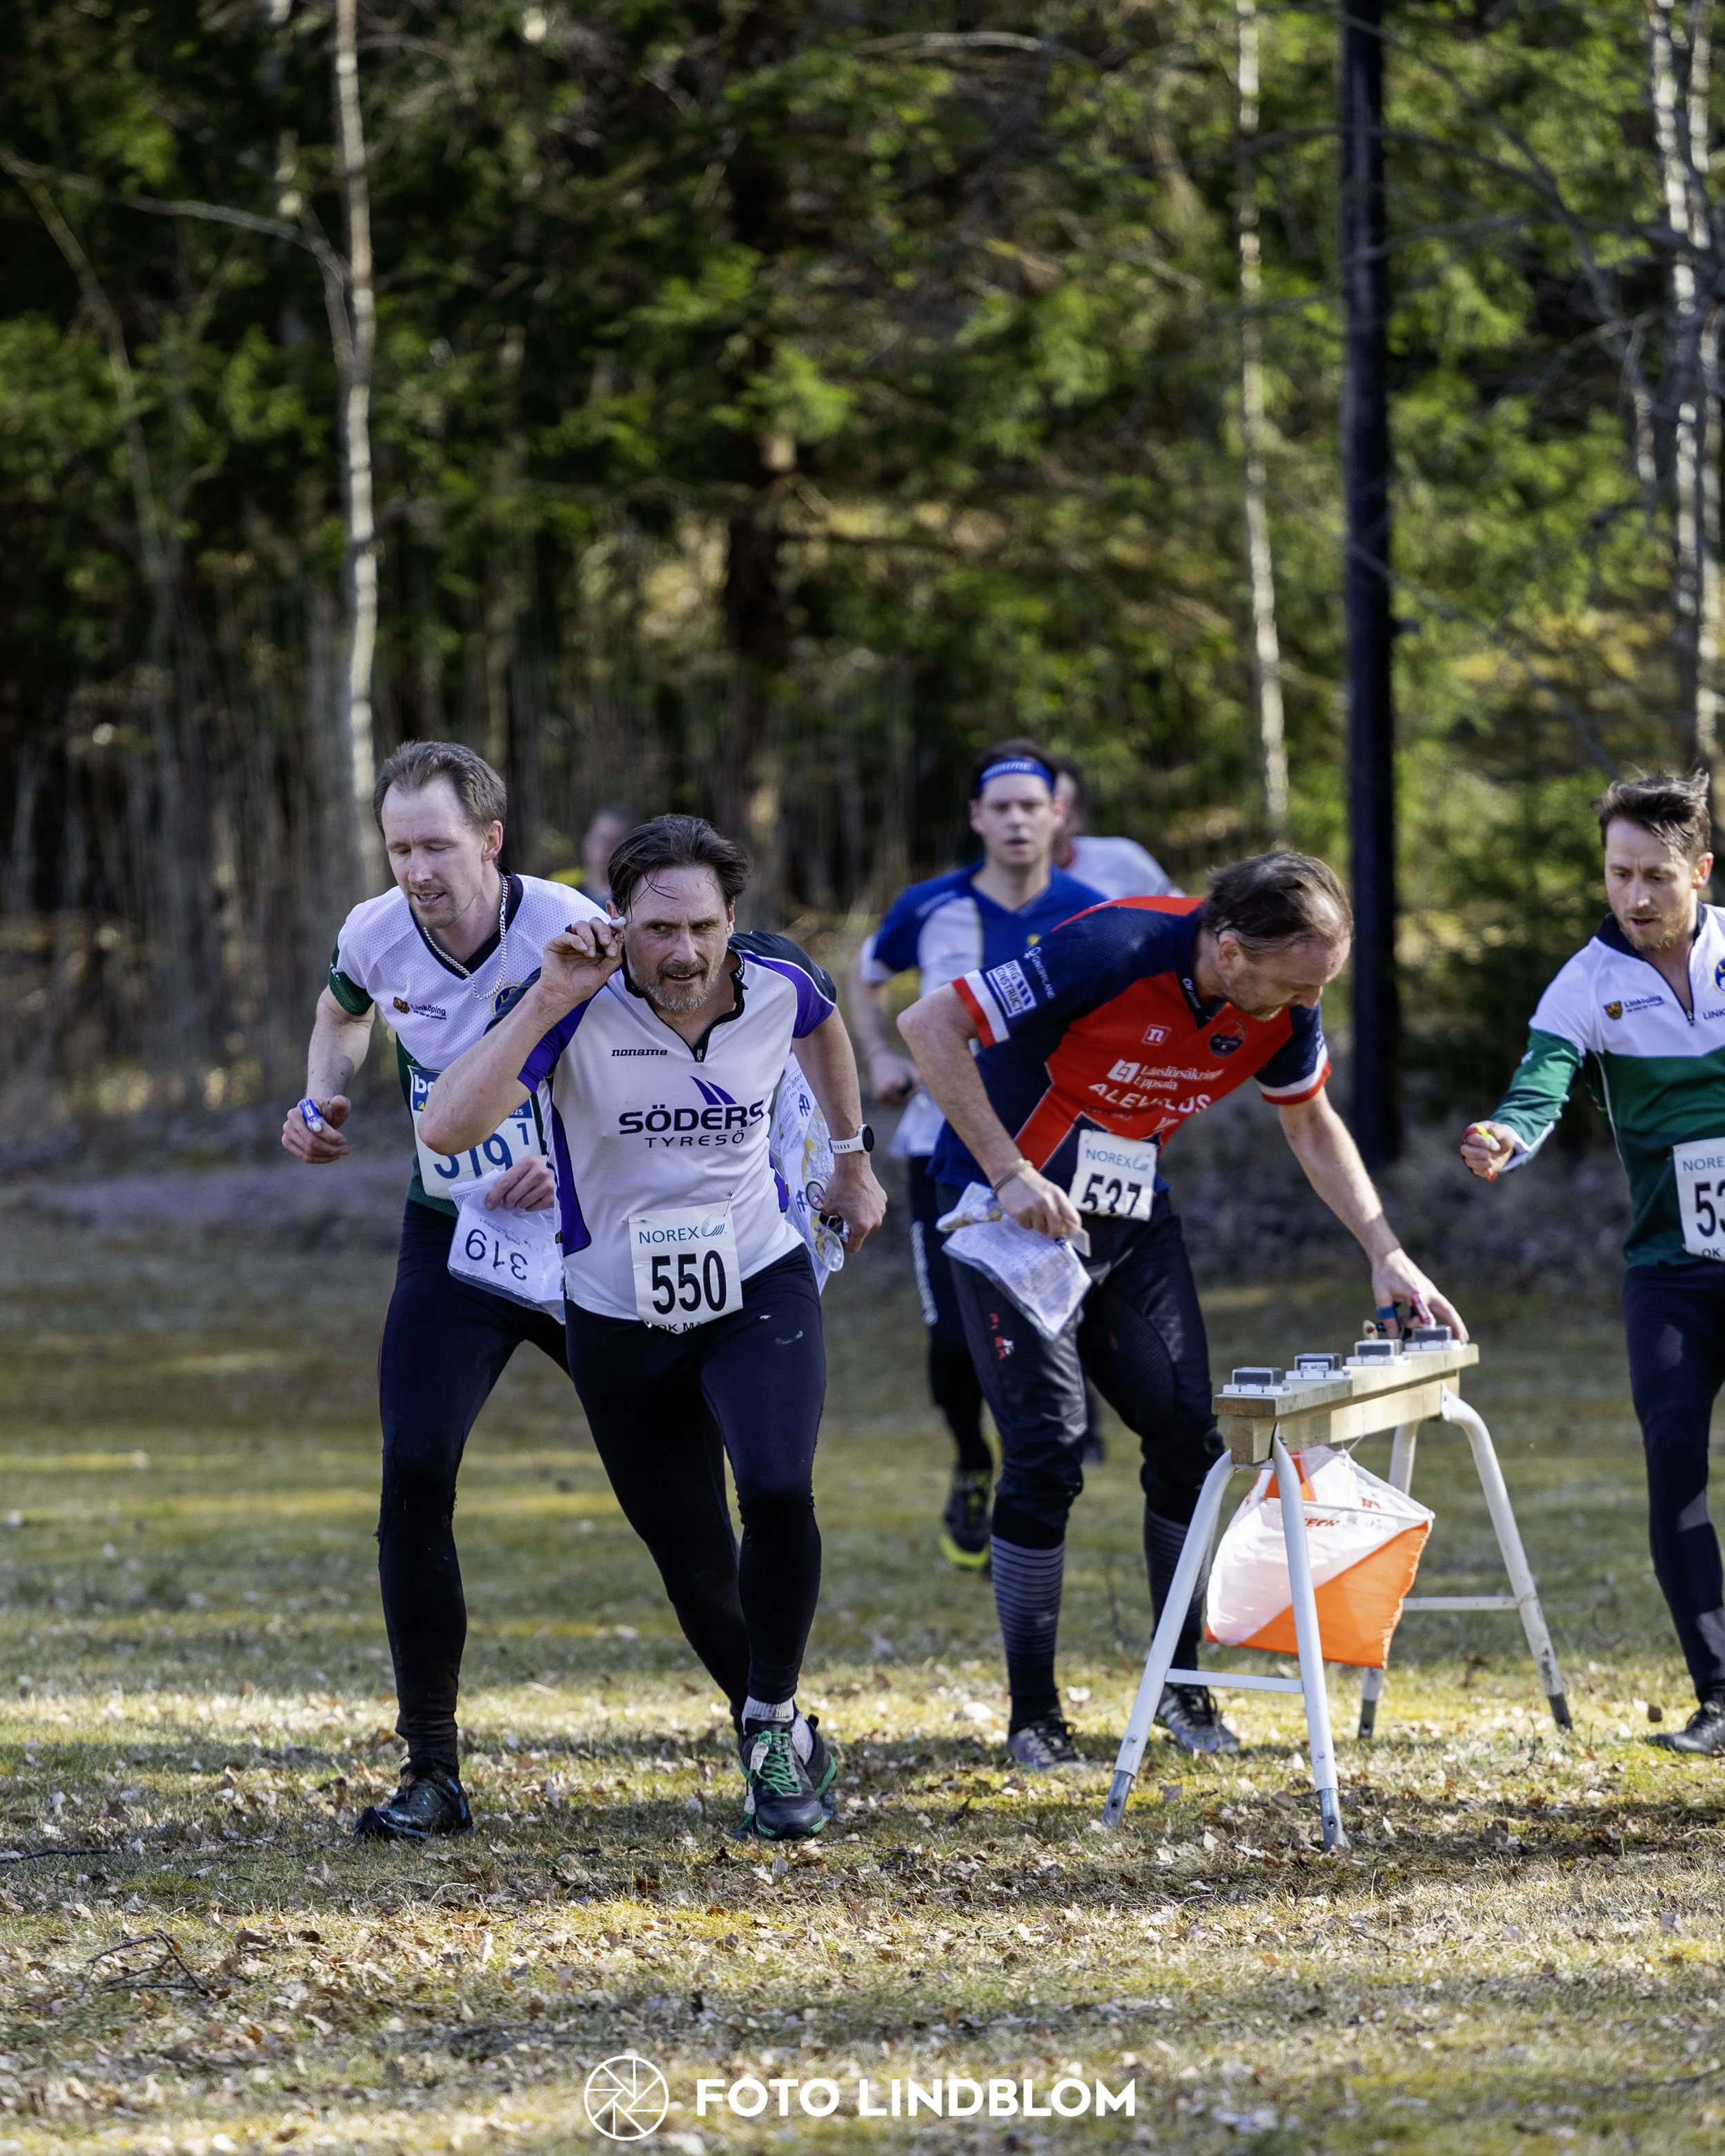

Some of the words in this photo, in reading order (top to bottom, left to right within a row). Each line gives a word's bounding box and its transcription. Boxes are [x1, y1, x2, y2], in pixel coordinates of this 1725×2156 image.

[411, 1004, 446, 1016] Linköping
[611, 1049, 668, 1057] noname
[618, 1099, 765, 1135] SÖDERS
[516, 1122, 529, 1145] 1
[644, 1129, 745, 1148] TYRESÖ
[1086, 1148, 1132, 1169] NOREX
[639, 1226, 700, 1244] NOREX
[465, 1228, 528, 1281] 319
[651, 1249, 727, 1315] 550
